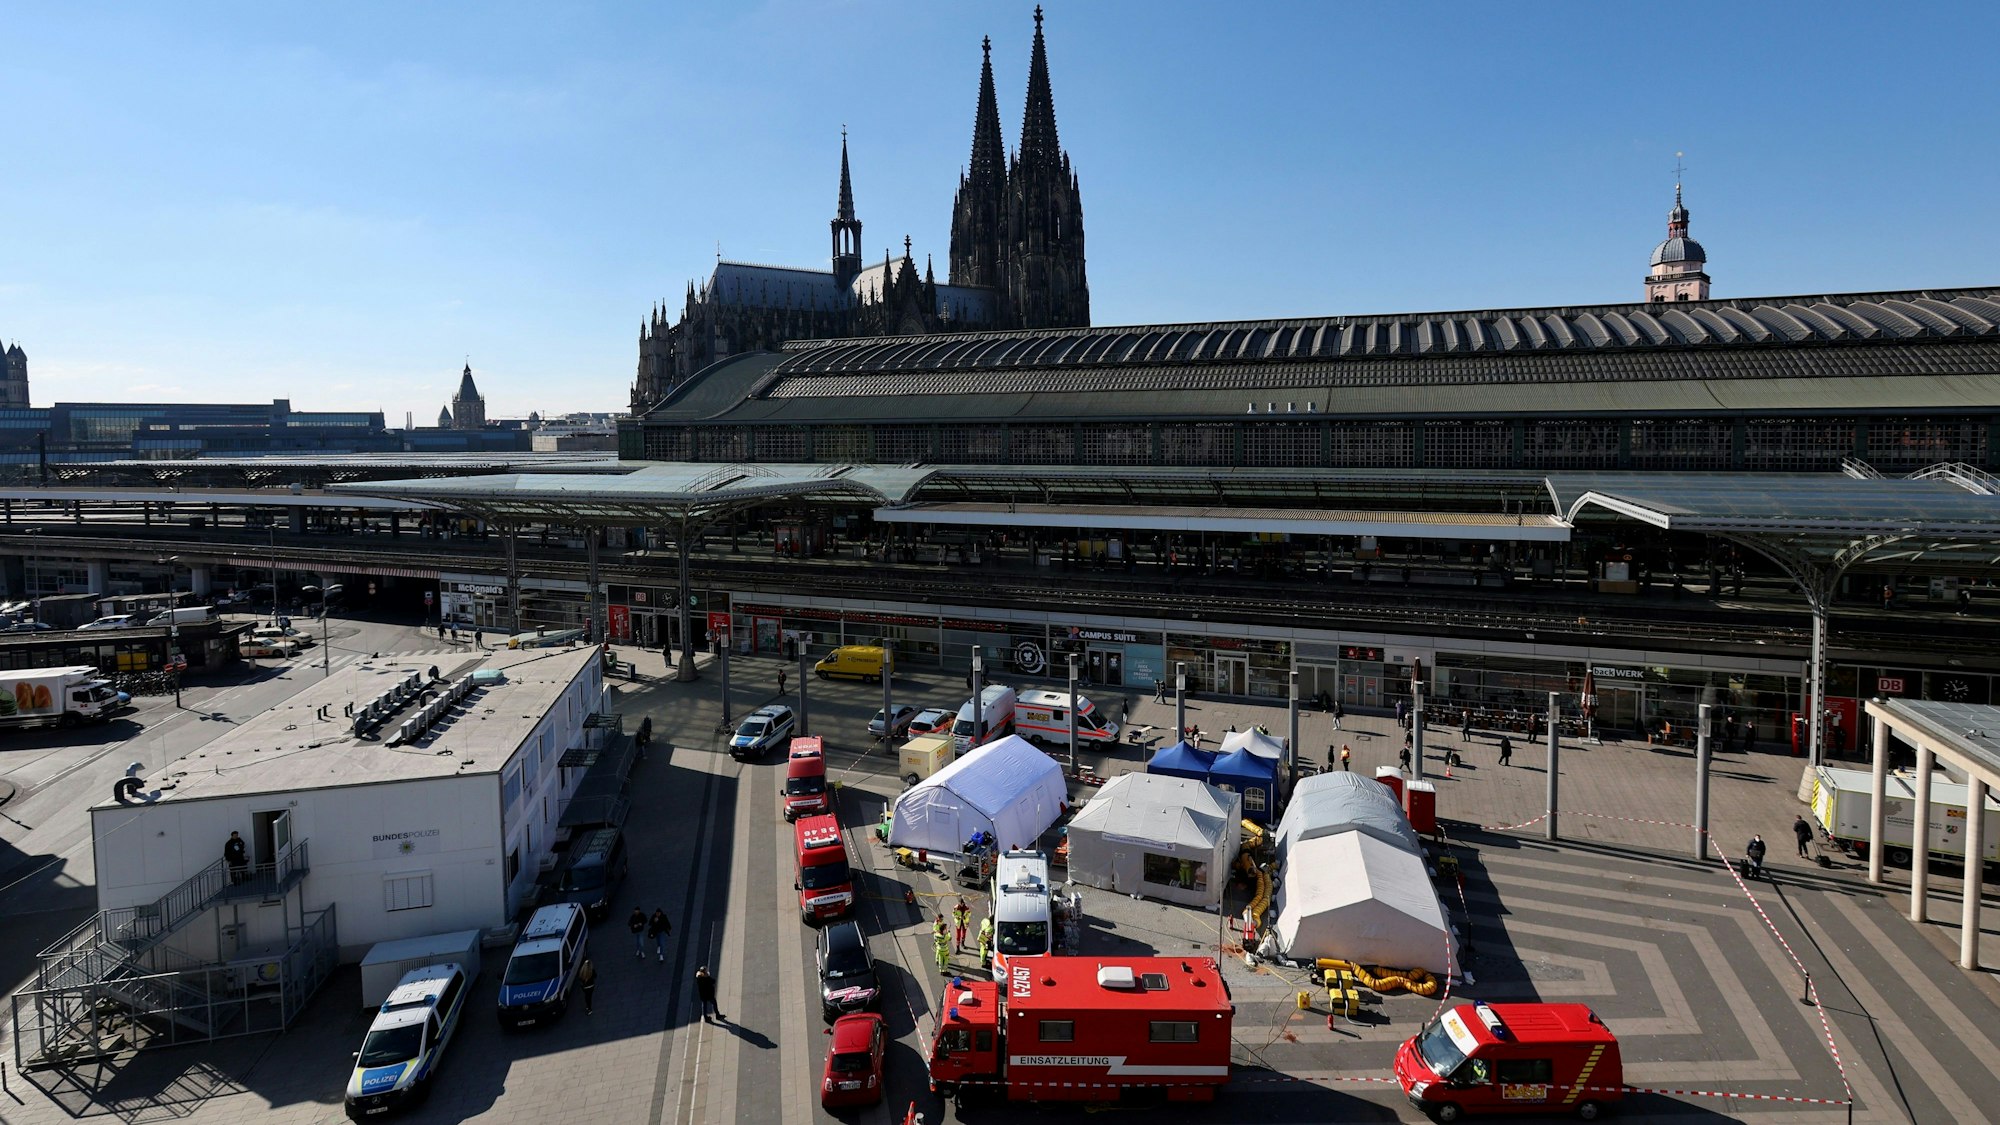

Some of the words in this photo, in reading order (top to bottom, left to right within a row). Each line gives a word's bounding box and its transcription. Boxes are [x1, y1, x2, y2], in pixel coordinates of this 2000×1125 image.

[458, 584, 503, 594] McDonald's
[635, 592, 646, 601] DB
[1079, 631, 1111, 640] CAMPUS
[1114, 633, 1136, 642] SUITE
[1880, 679, 1902, 691] DB
[372, 829, 440, 842] BUNDESPOLIZEI
[814, 894, 844, 903] FEUERWEHR
[1013, 966, 1031, 997] K-27457
[513, 991, 541, 1000] POLIZEI
[1020, 1056, 1109, 1065] EINSATZLEITUNG
[363, 1074, 398, 1087] POLIZEI
